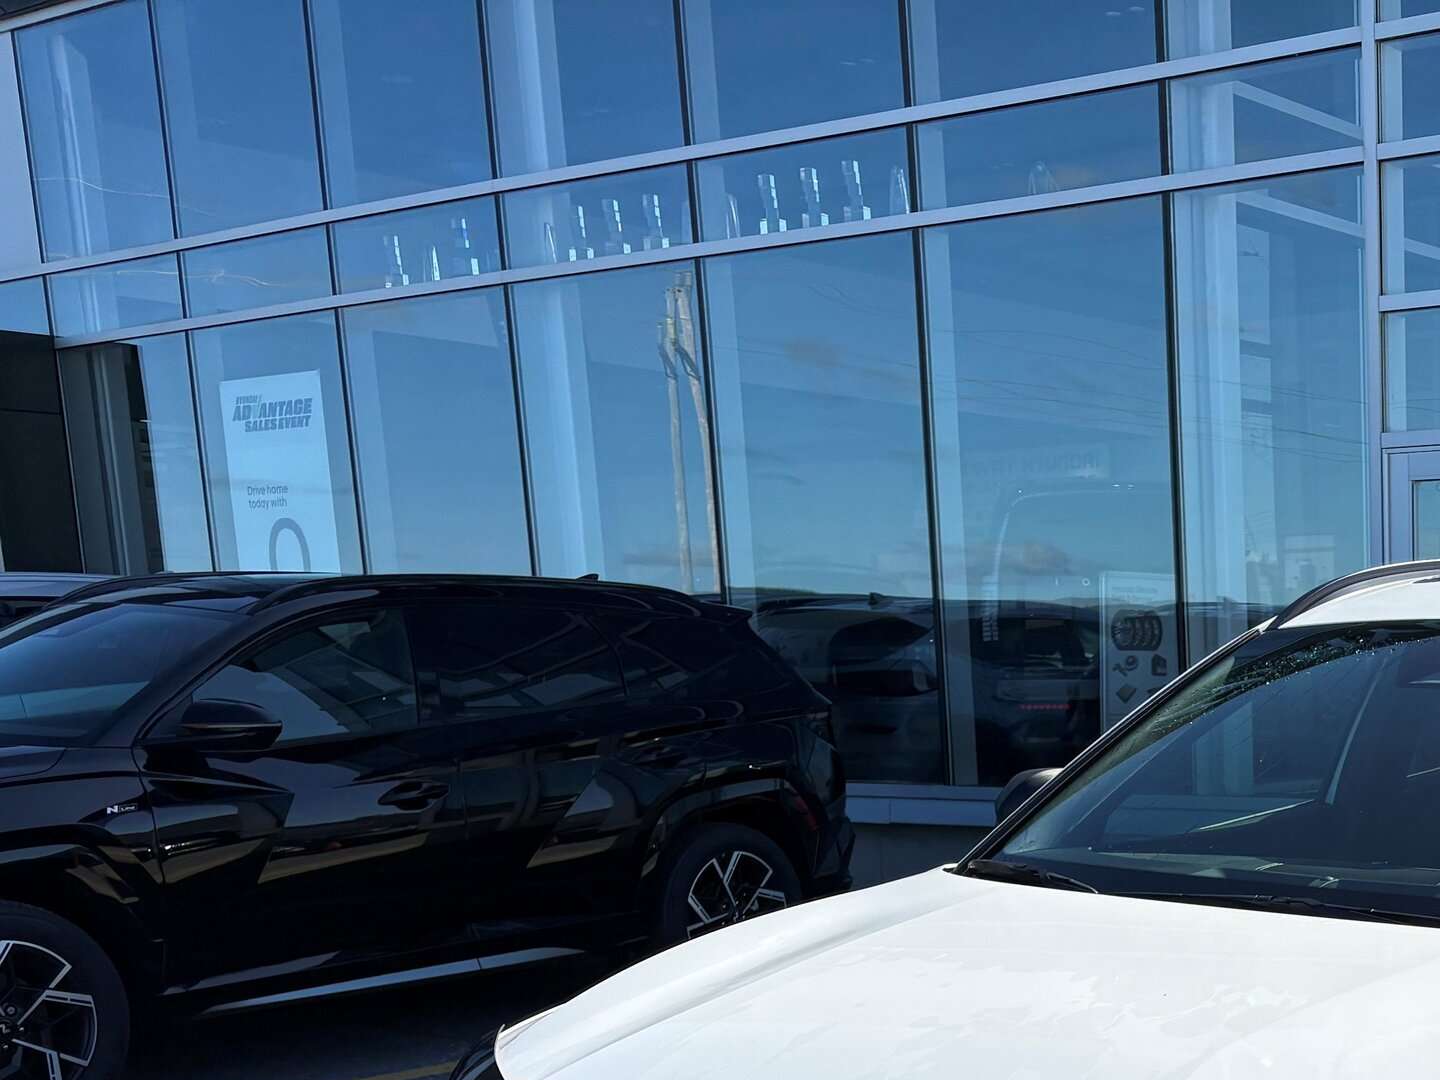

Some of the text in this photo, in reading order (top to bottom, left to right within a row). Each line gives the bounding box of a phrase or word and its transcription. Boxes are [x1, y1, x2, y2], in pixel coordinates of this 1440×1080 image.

[247, 485, 288, 496] Drive home
[248, 498, 270, 510] today
